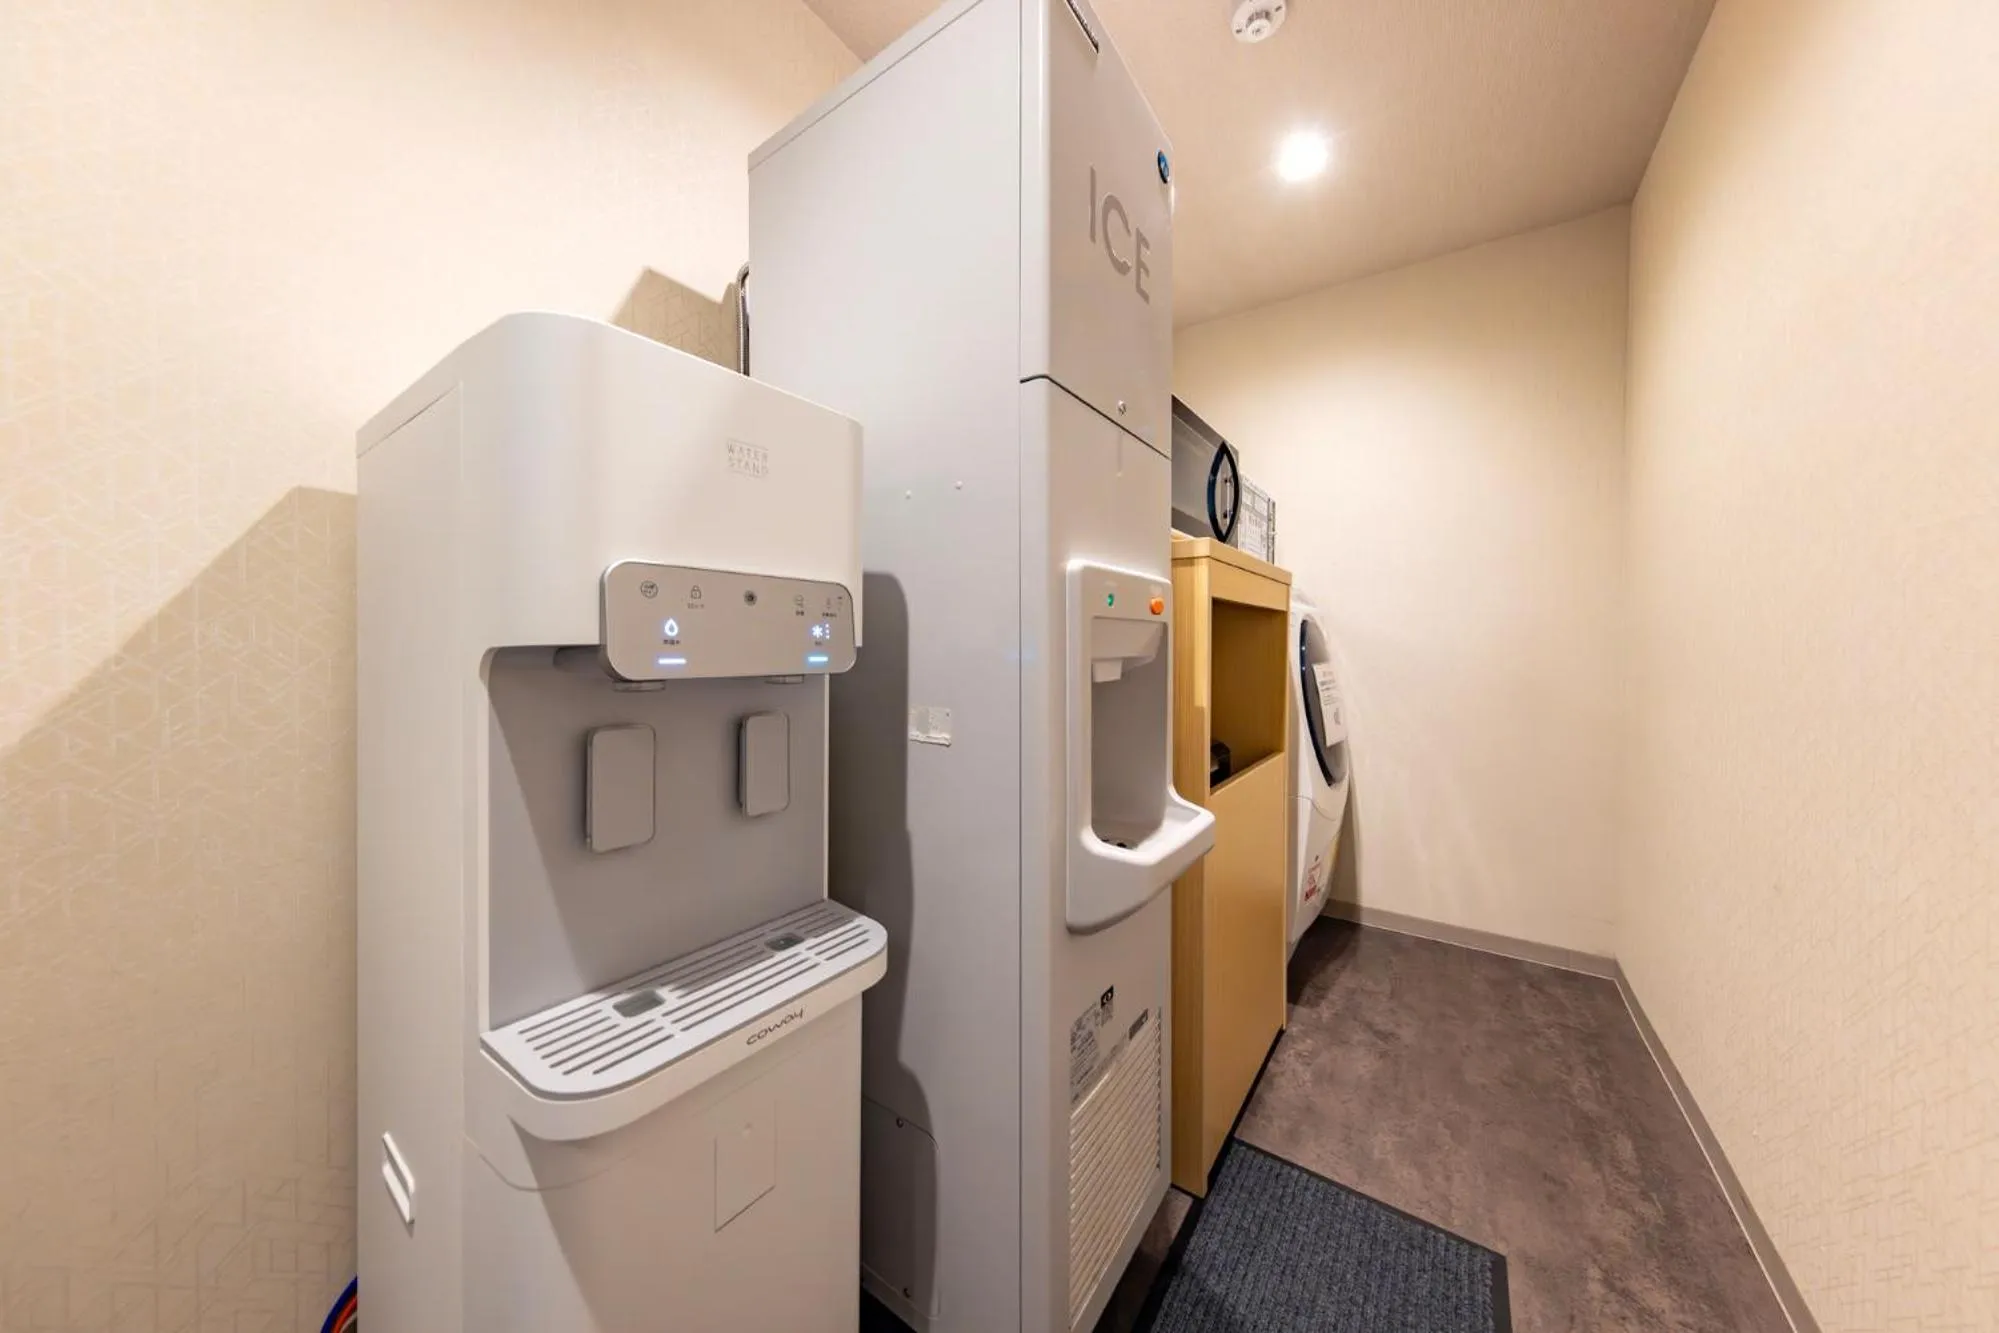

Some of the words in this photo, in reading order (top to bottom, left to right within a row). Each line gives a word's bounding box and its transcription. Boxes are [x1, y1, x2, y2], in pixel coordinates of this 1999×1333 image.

[1089, 166, 1150, 305] ICE
[727, 444, 768, 462] WATER
[728, 457, 769, 475] STAND
[746, 1007, 804, 1045] coway
